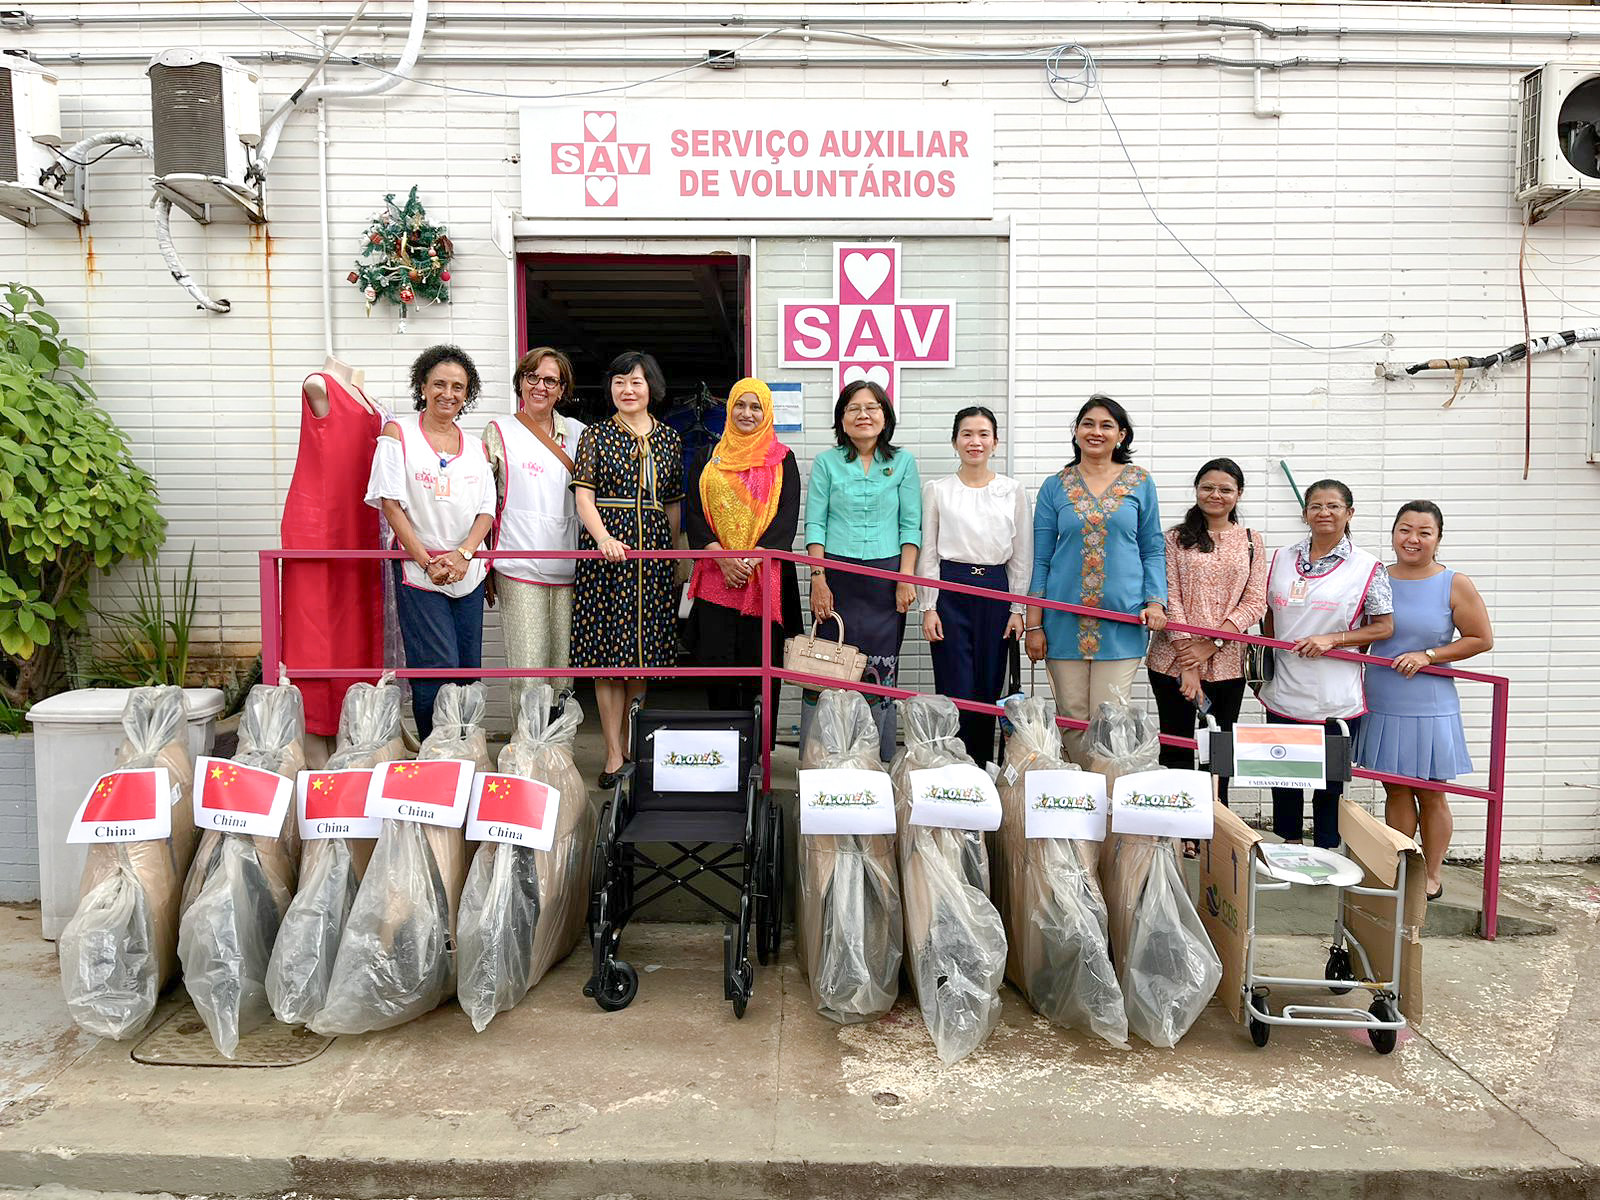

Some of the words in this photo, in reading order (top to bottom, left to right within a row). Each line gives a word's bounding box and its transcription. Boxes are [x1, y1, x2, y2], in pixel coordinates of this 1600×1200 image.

[670, 129, 809, 165] SERVIÇO
[819, 130, 969, 158] AUXILIAR
[556, 144, 648, 174] SAV
[679, 169, 720, 197] DE
[729, 163, 956, 198] VOLUNTÁRIOS
[792, 307, 945, 359] SAV
[397, 804, 435, 819] China
[212, 813, 247, 828] China
[316, 822, 349, 834] China
[94, 825, 136, 838] China
[488, 825, 523, 840] China
